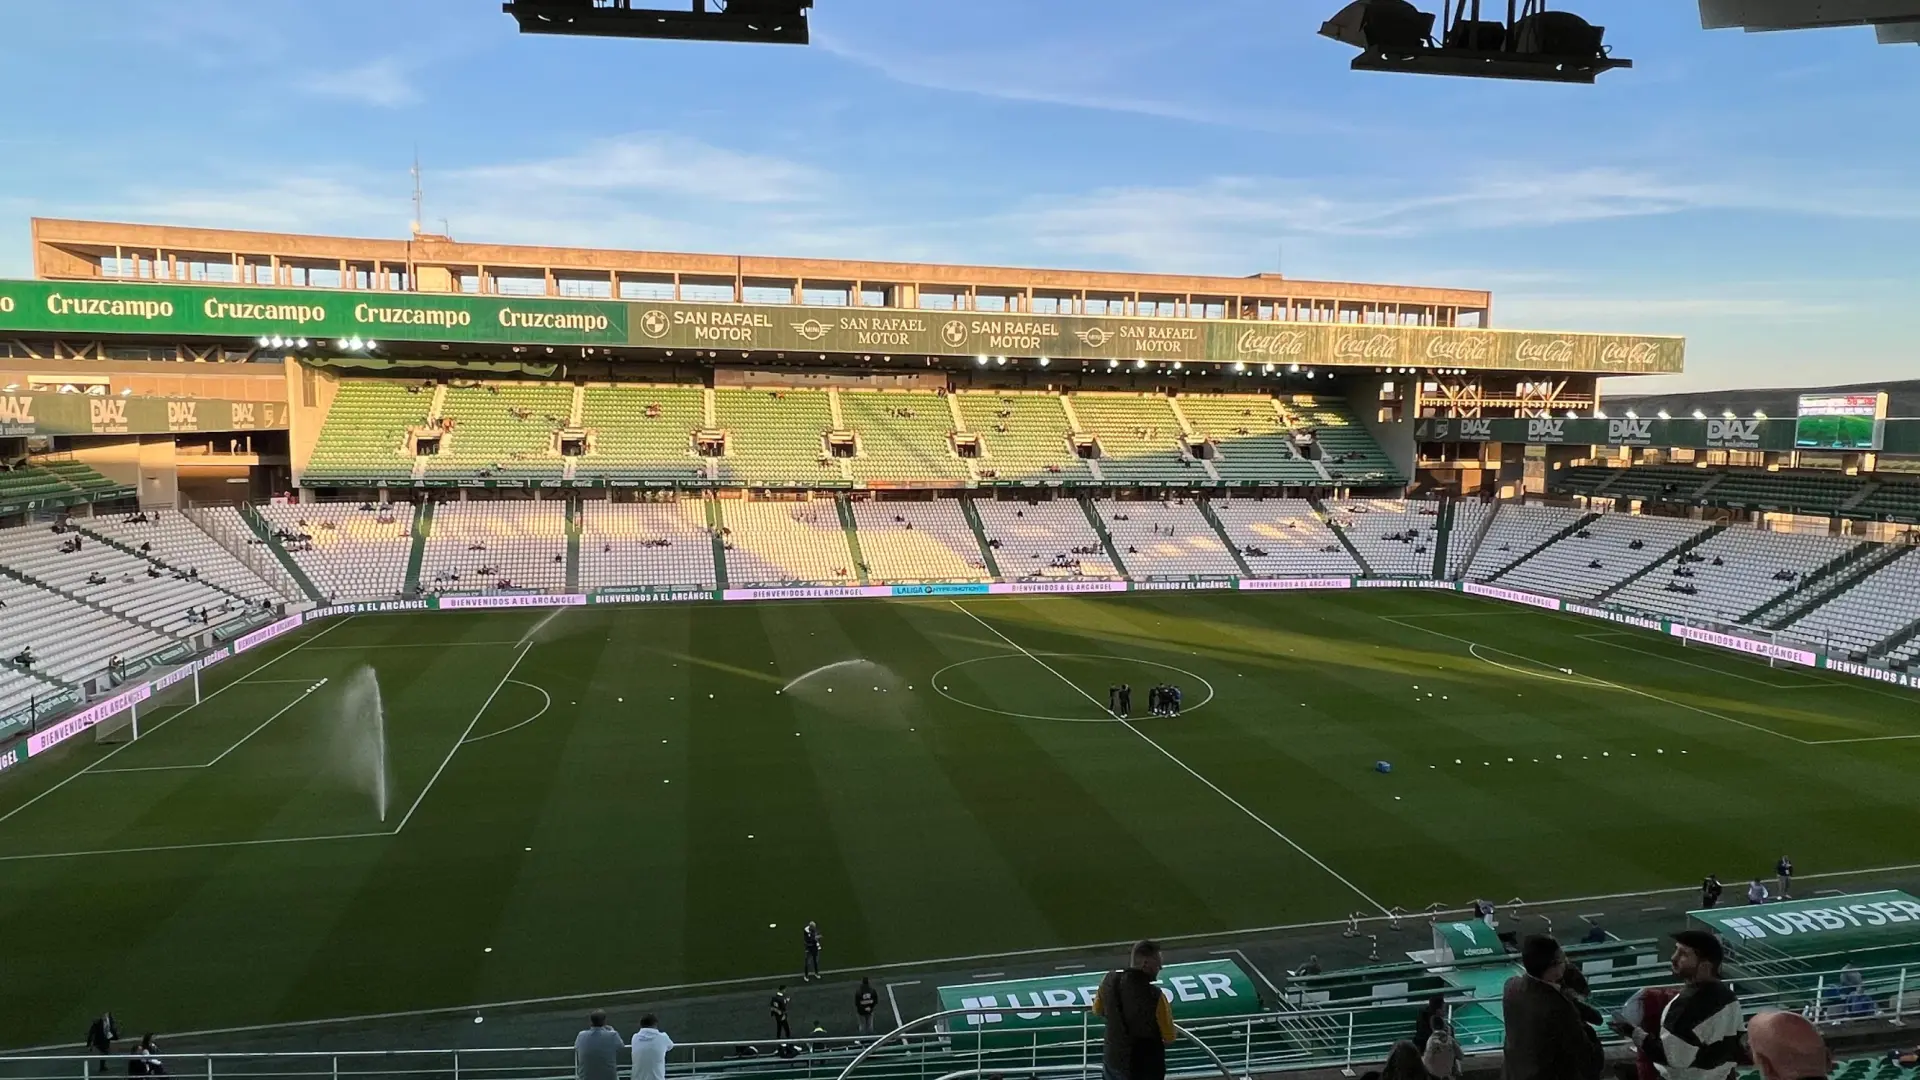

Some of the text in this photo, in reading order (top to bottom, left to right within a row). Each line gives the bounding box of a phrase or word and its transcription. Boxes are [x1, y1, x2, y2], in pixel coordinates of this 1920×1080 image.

[47, 292, 173, 319] Cruzcampo
[204, 297, 325, 324] Cruzcampo
[354, 302, 471, 329] Cruzcampo
[498, 307, 608, 333] Cruzcampo
[674, 311, 773, 328] SAN RAFAEL
[840, 317, 926, 332] SAN RAFAEL
[971, 321, 1001, 335] SAN
[1004, 322, 1059, 336] RAFAEL
[695, 326, 752, 341] MOTOR
[858, 331, 909, 345] MOTOR
[1119, 326, 1197, 340] SAN RAFAEL
[990, 335, 1041, 349] MOTOR
[1135, 339, 1182, 352] MOTOR
[0, 396, 35, 423] IAZ
[451, 597, 509, 606] BIENVENIDOS
[596, 594, 650, 603] BIENVENIDOS
[753, 590, 804, 598] BIENVENIDOS
[306, 604, 356, 620] BIENVENIDOS
[358, 604, 364, 612] A
[366, 603, 378, 611] EL
[1566, 602, 1608, 619] BIENVENIDOS
[1736, 640, 1741, 648] A
[1826, 658, 1897, 682] BIENVENIDOS
[1899, 674, 1908, 686] A
[40, 713, 92, 748] BIENVENIDOS
[94, 712, 99, 720] A
[100, 708, 109, 719] EL
[1751, 900, 1920, 936] URBYSER
